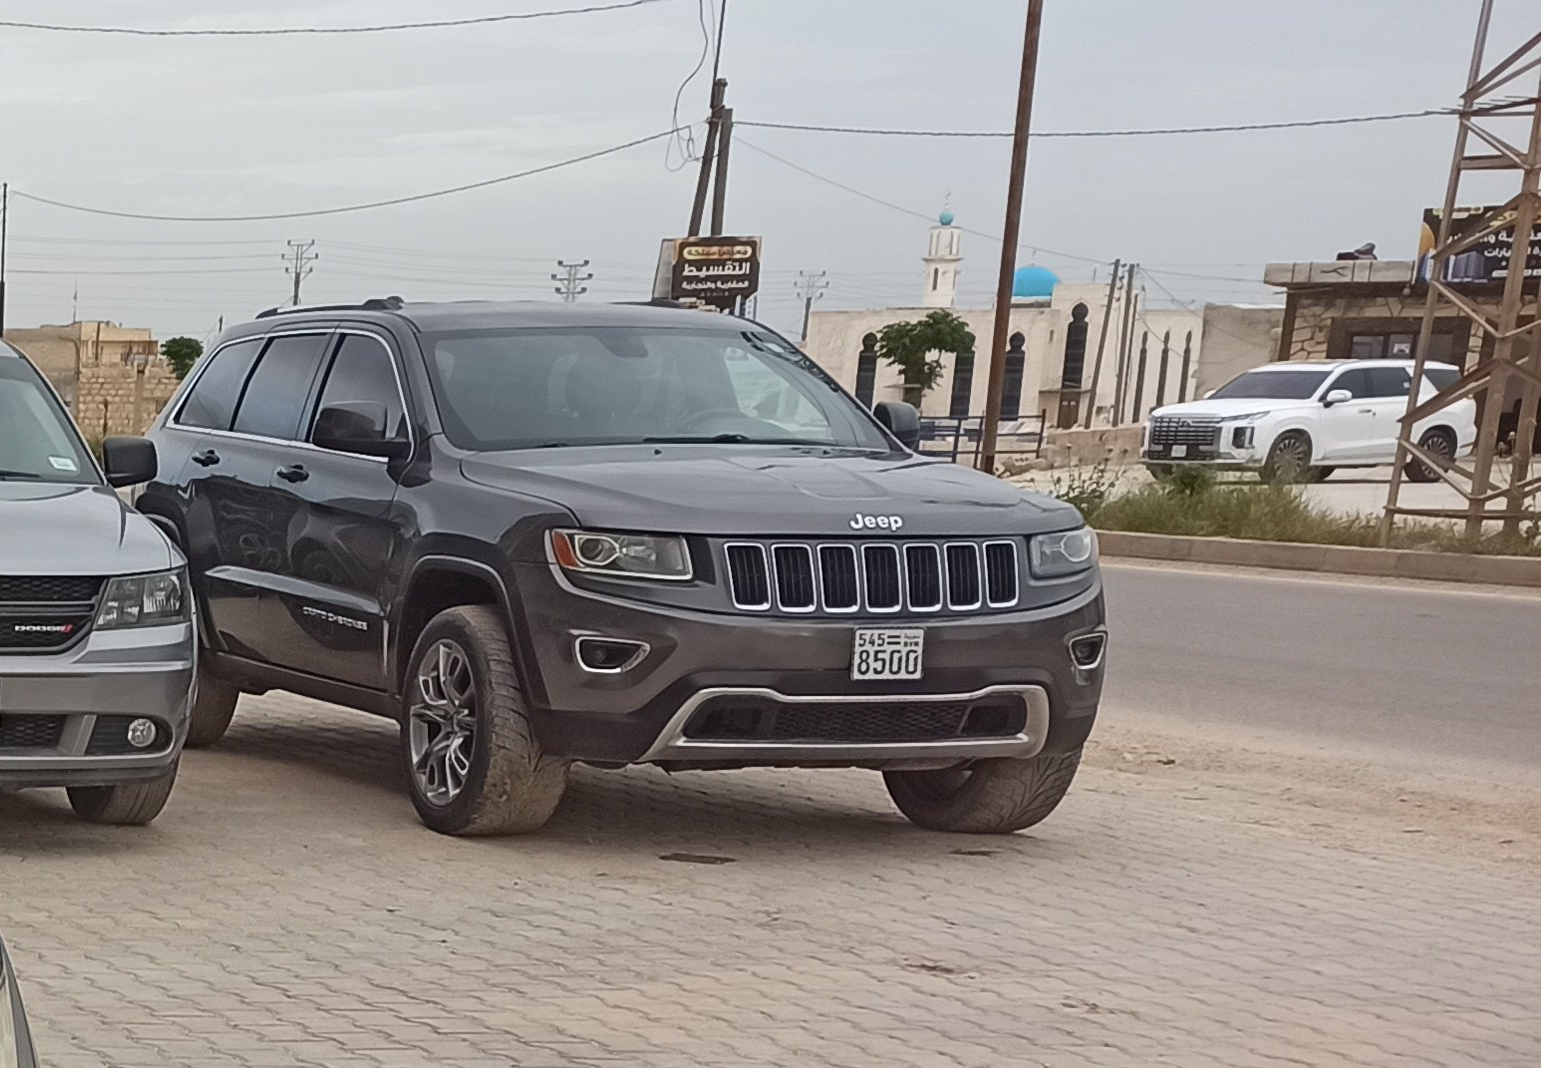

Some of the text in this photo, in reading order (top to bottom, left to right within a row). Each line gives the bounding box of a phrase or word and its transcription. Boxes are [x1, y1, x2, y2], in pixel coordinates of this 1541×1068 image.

[682, 261, 750, 277] التقسيط
[850, 513, 903, 531] Jeep
[858, 633, 885, 647] 545
[857, 649, 919, 675] 8500
